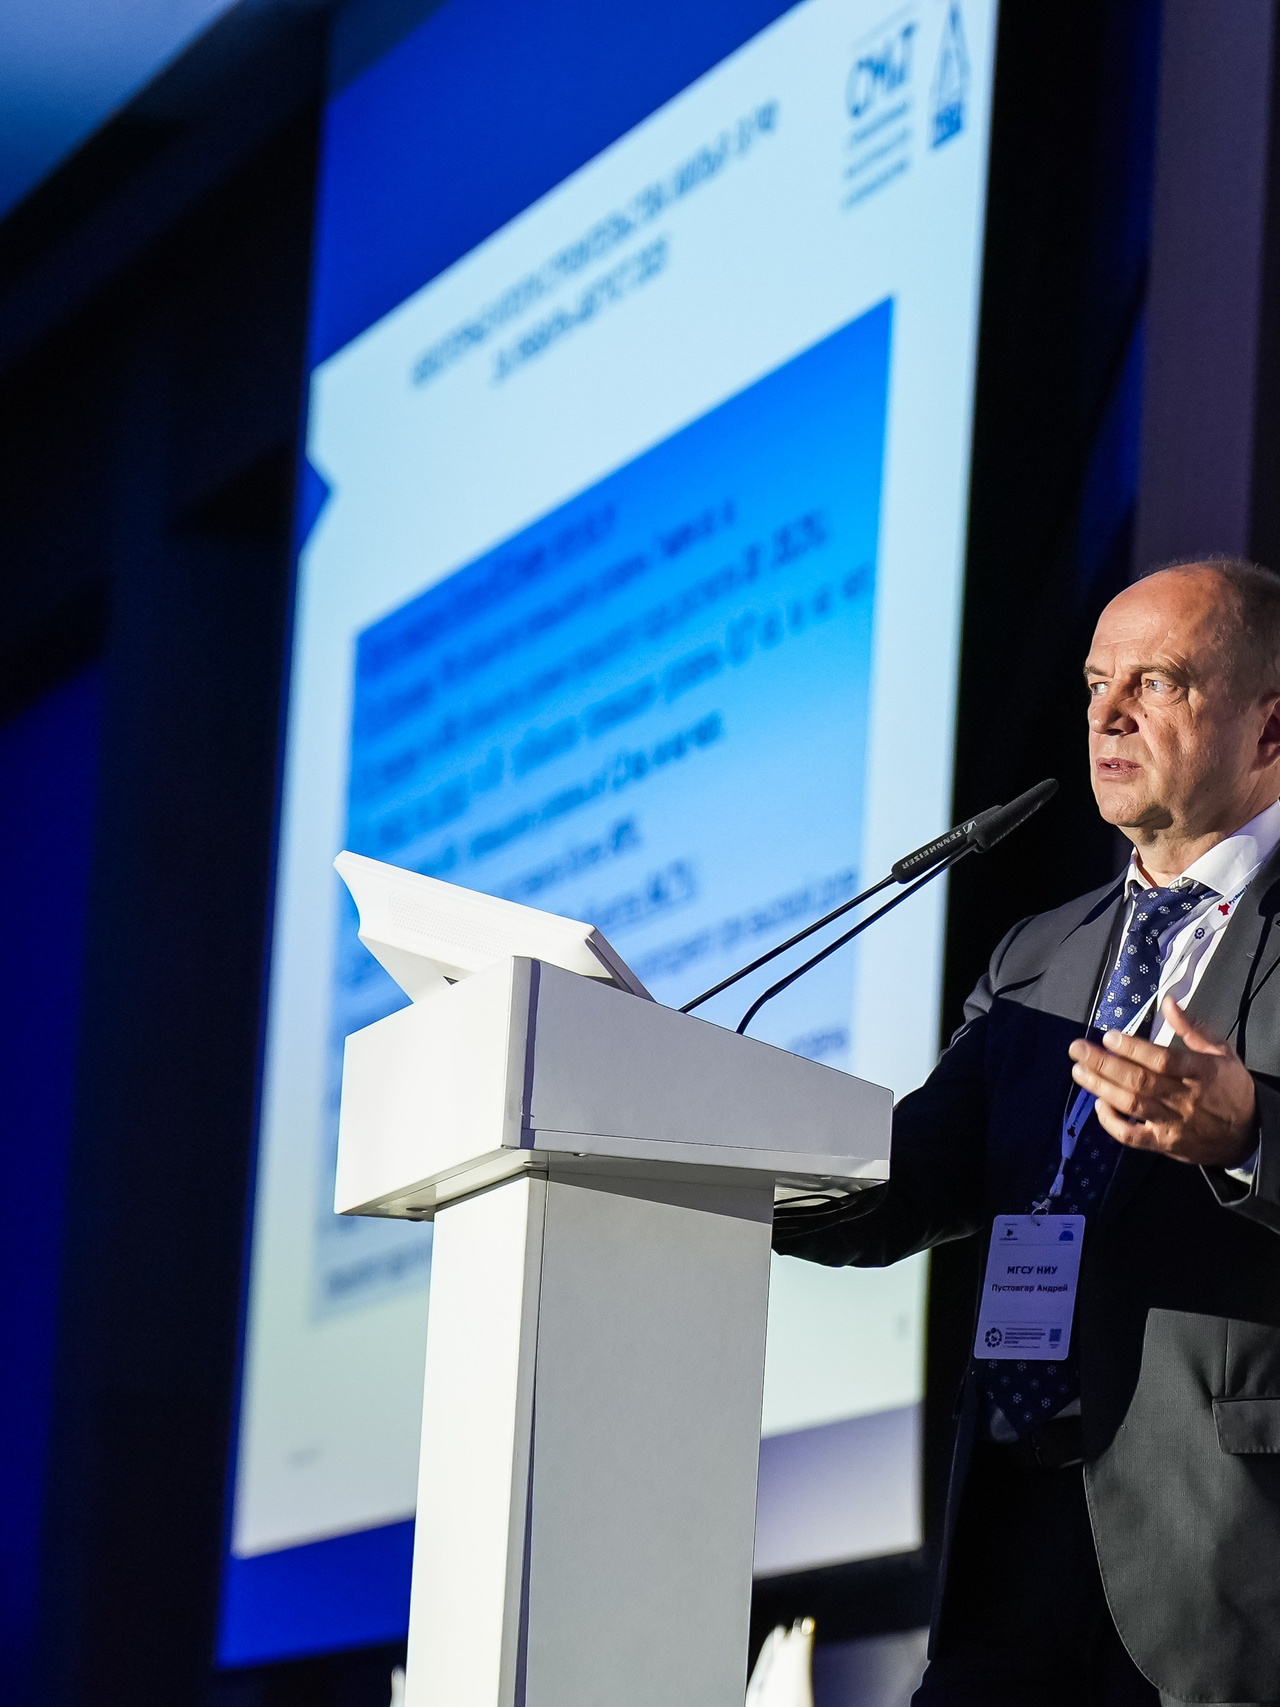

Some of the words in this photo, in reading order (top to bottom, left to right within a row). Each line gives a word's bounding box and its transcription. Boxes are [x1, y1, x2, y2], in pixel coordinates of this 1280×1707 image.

[901, 829, 962, 870] SENNHEISER
[1006, 1265, 1035, 1275] МГСУ
[1036, 1265, 1059, 1275] НИУ
[1036, 1283, 1069, 1293] Андрей
